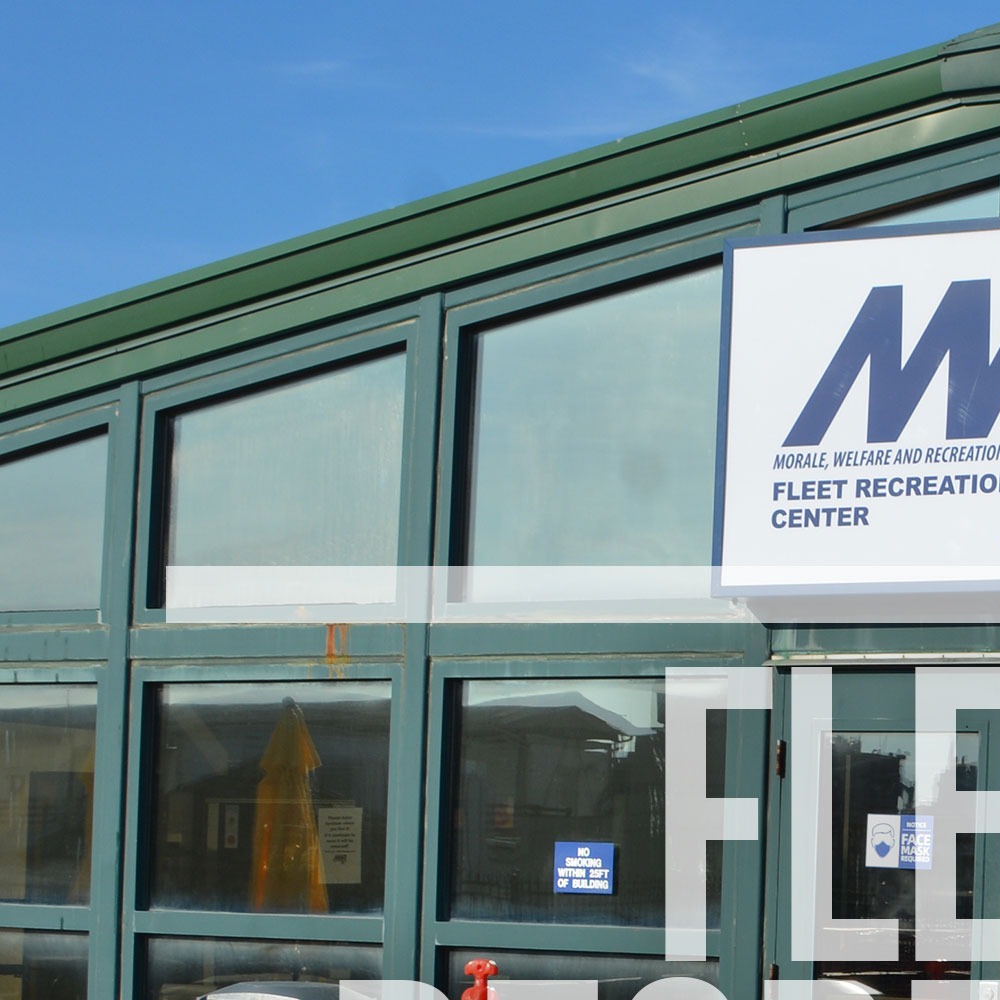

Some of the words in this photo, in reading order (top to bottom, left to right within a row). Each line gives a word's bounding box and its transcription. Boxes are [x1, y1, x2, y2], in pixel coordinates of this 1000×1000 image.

[773, 453, 829, 470] MORALE,
[833, 449, 892, 467] WELFARE
[893, 447, 923, 464] AND
[772, 479, 848, 501] FLEET
[771, 506, 869, 529] CENTER
[901, 833, 931, 846] FACE
[577, 847, 590, 857] NO
[901, 845, 929, 856] MASK
[565, 857, 602, 868] SMOKING
[557, 867, 586, 878] WITHIN
[589, 868, 610, 878] 25FT
[557, 878, 569, 888] OF
[572, 879, 609, 889] BUILDING
